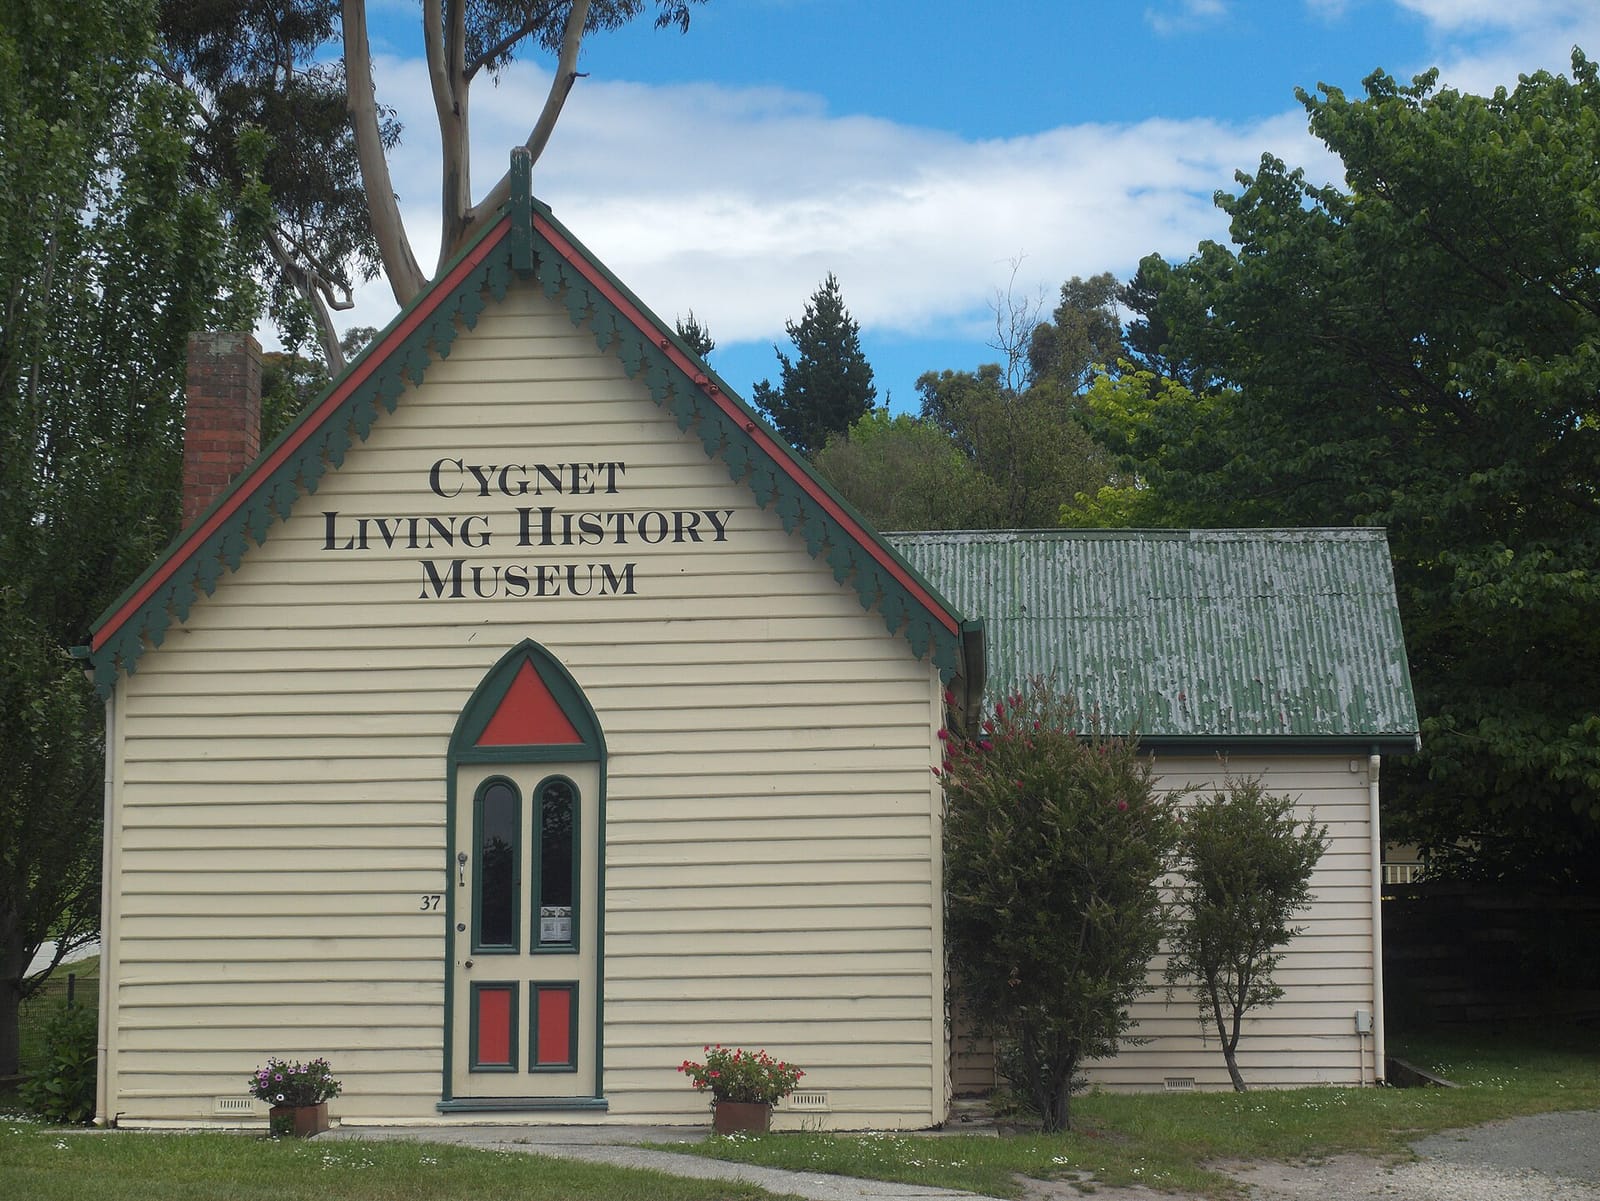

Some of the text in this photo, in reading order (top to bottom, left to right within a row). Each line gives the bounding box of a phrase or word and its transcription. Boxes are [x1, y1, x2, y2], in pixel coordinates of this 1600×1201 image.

[429, 458, 626, 498] CYGNET
[321, 506, 735, 551] LIVING HISTORY
[418, 559, 637, 599] MUSEUM
[420, 895, 441, 911] 37
